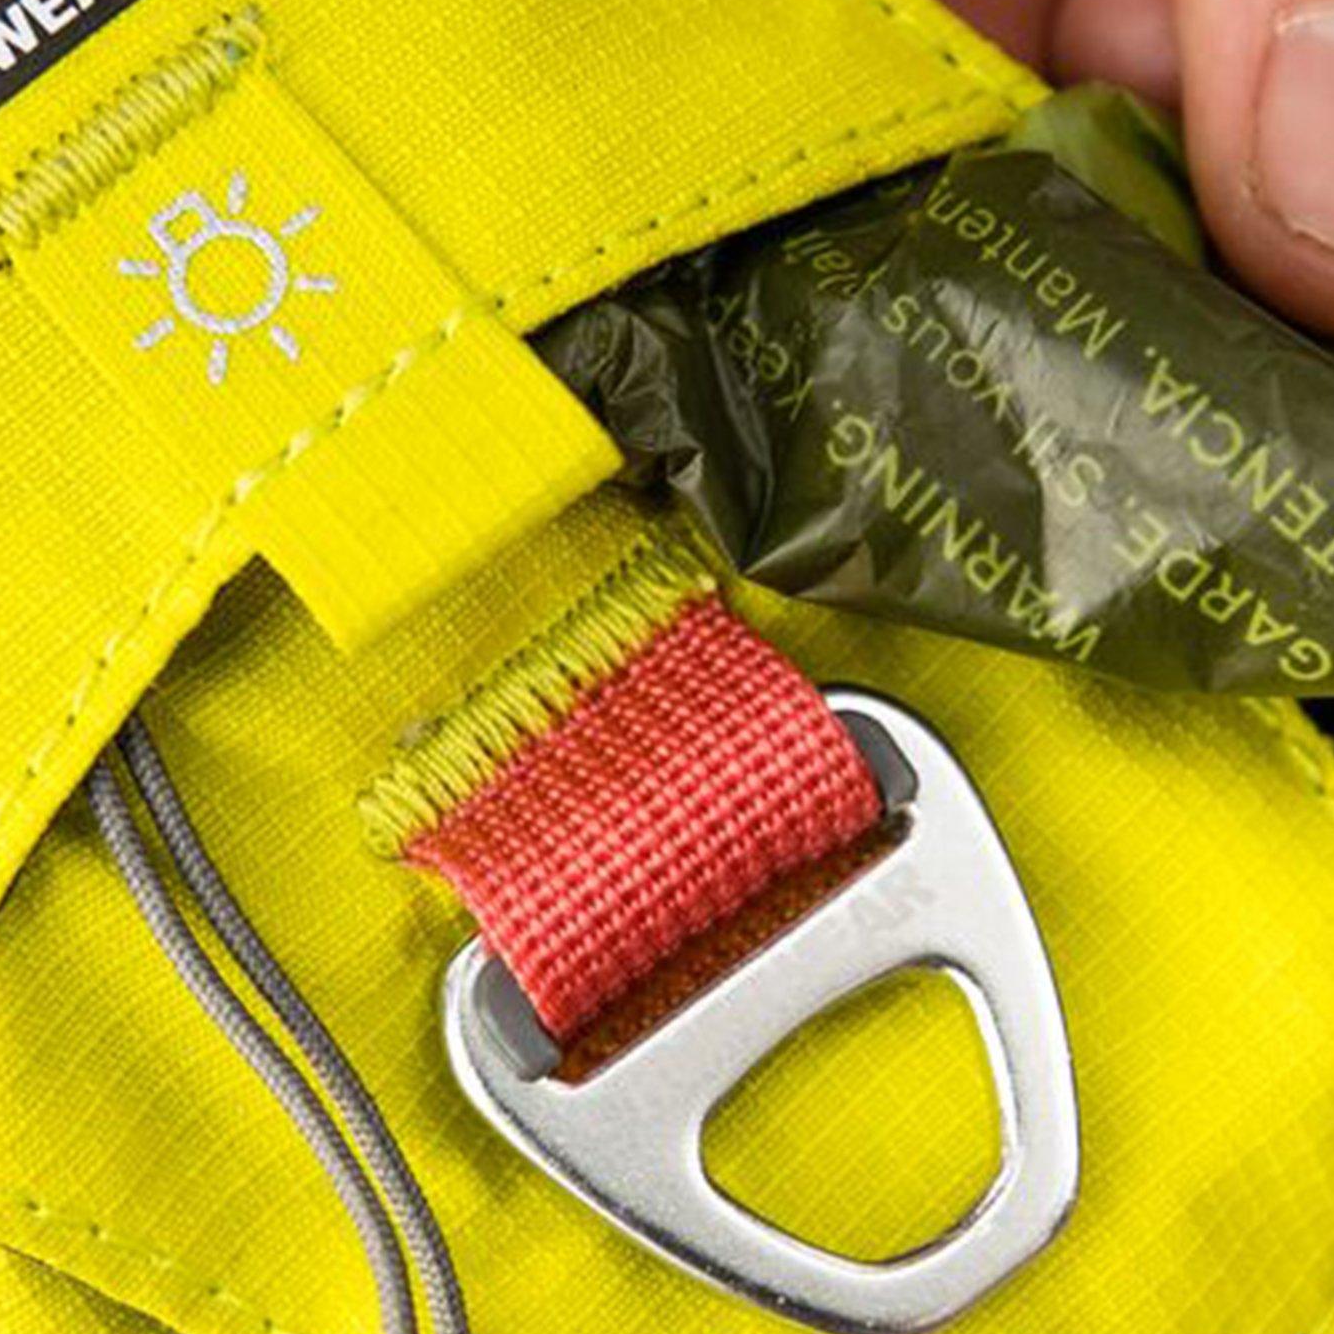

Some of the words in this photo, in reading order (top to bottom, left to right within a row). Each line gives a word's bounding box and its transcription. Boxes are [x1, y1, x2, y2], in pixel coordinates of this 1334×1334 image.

[881, 293, 1016, 421] vous
[827, 399, 1101, 662] WARNING.
[1112, 495, 1332, 682] GARDE.
